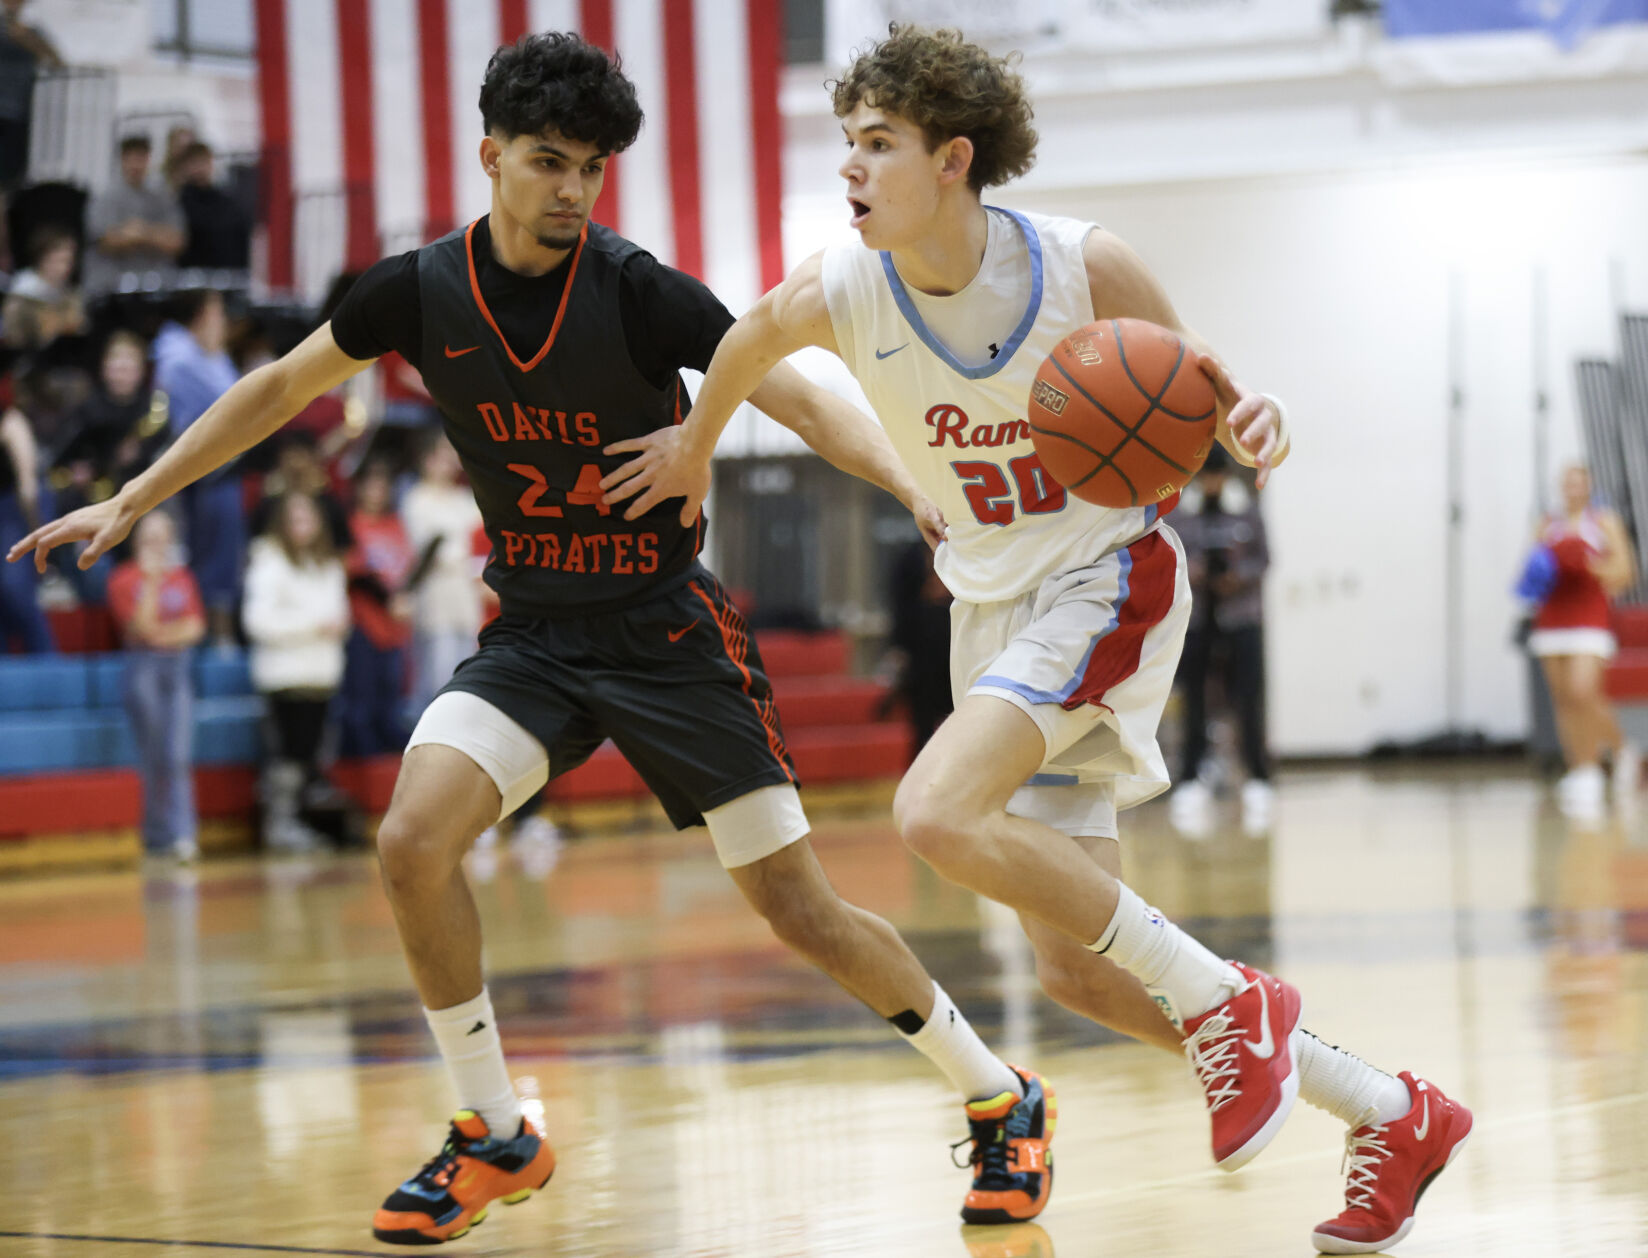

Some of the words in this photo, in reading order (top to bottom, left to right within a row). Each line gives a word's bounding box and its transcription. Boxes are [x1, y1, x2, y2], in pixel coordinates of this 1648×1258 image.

[476, 402, 600, 446] DAVIS
[924, 404, 1031, 448] Ram
[506, 463, 611, 518] 24
[949, 451, 1068, 527] 20
[501, 530, 659, 574] PIRATES
